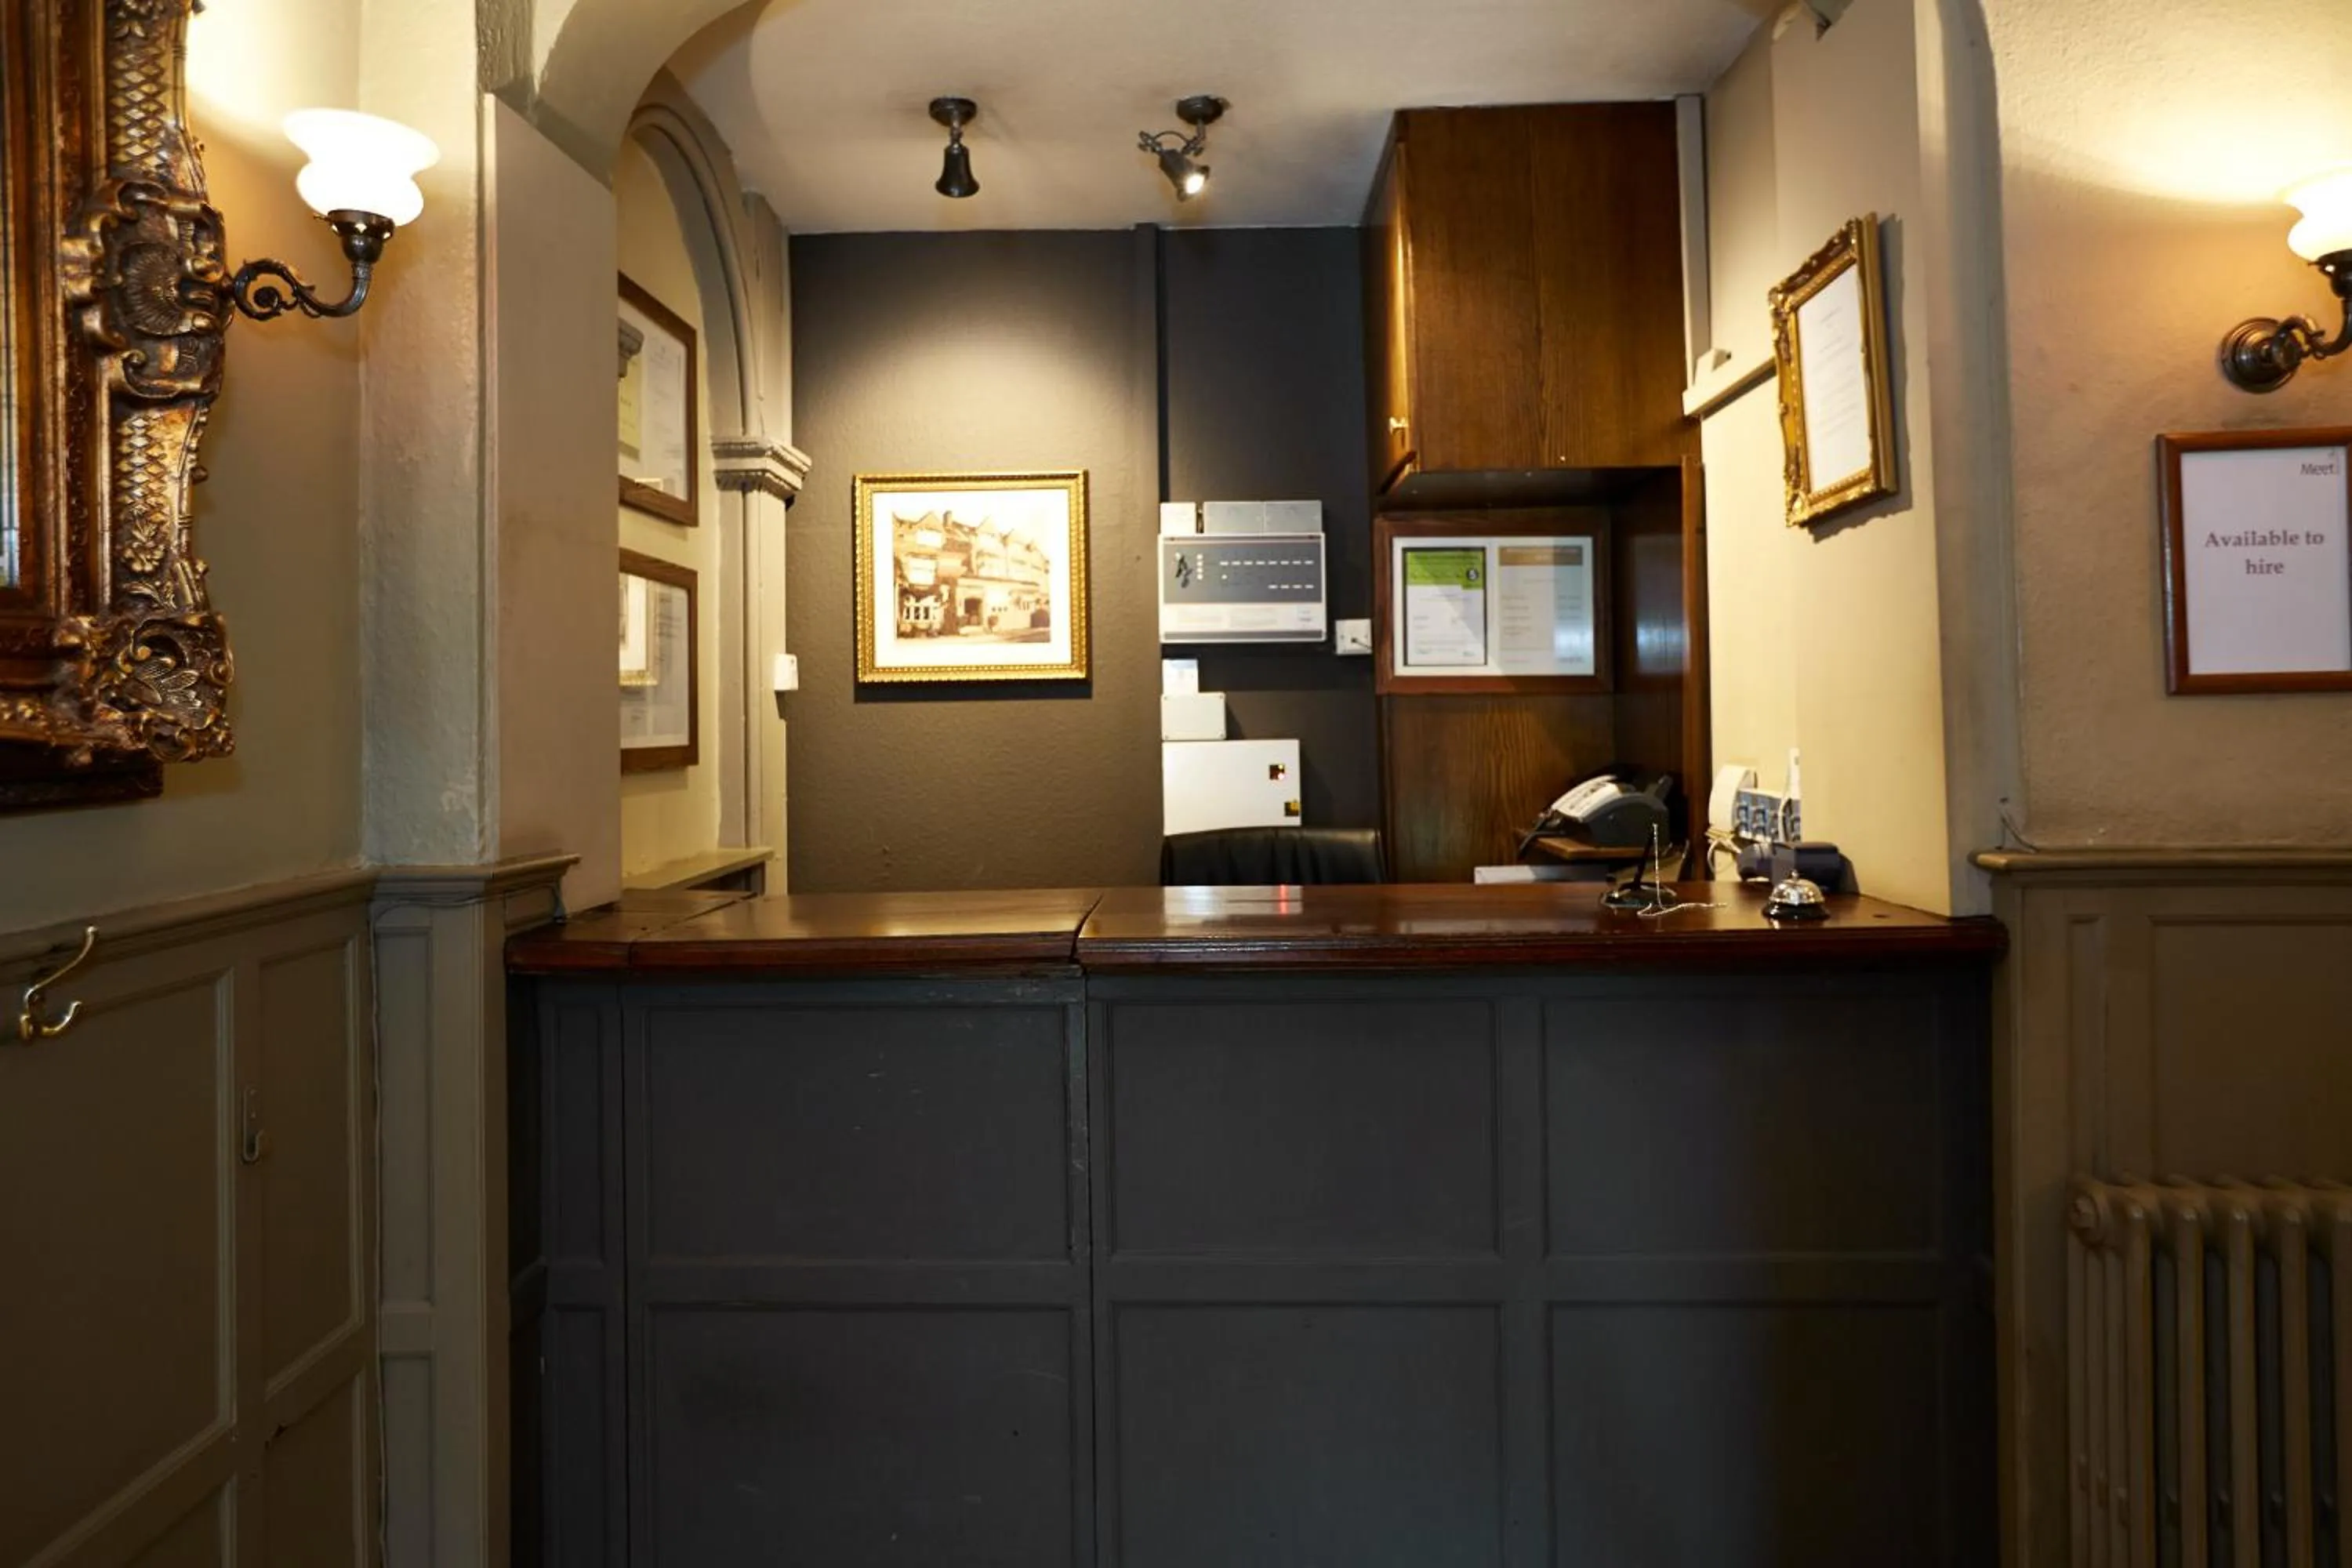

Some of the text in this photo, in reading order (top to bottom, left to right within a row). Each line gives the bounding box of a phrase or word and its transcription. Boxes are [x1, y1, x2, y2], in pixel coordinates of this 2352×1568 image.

[2300, 463, 2334, 476] Meet
[2205, 530, 2325, 548] Available to
[2245, 558, 2285, 575] hire
